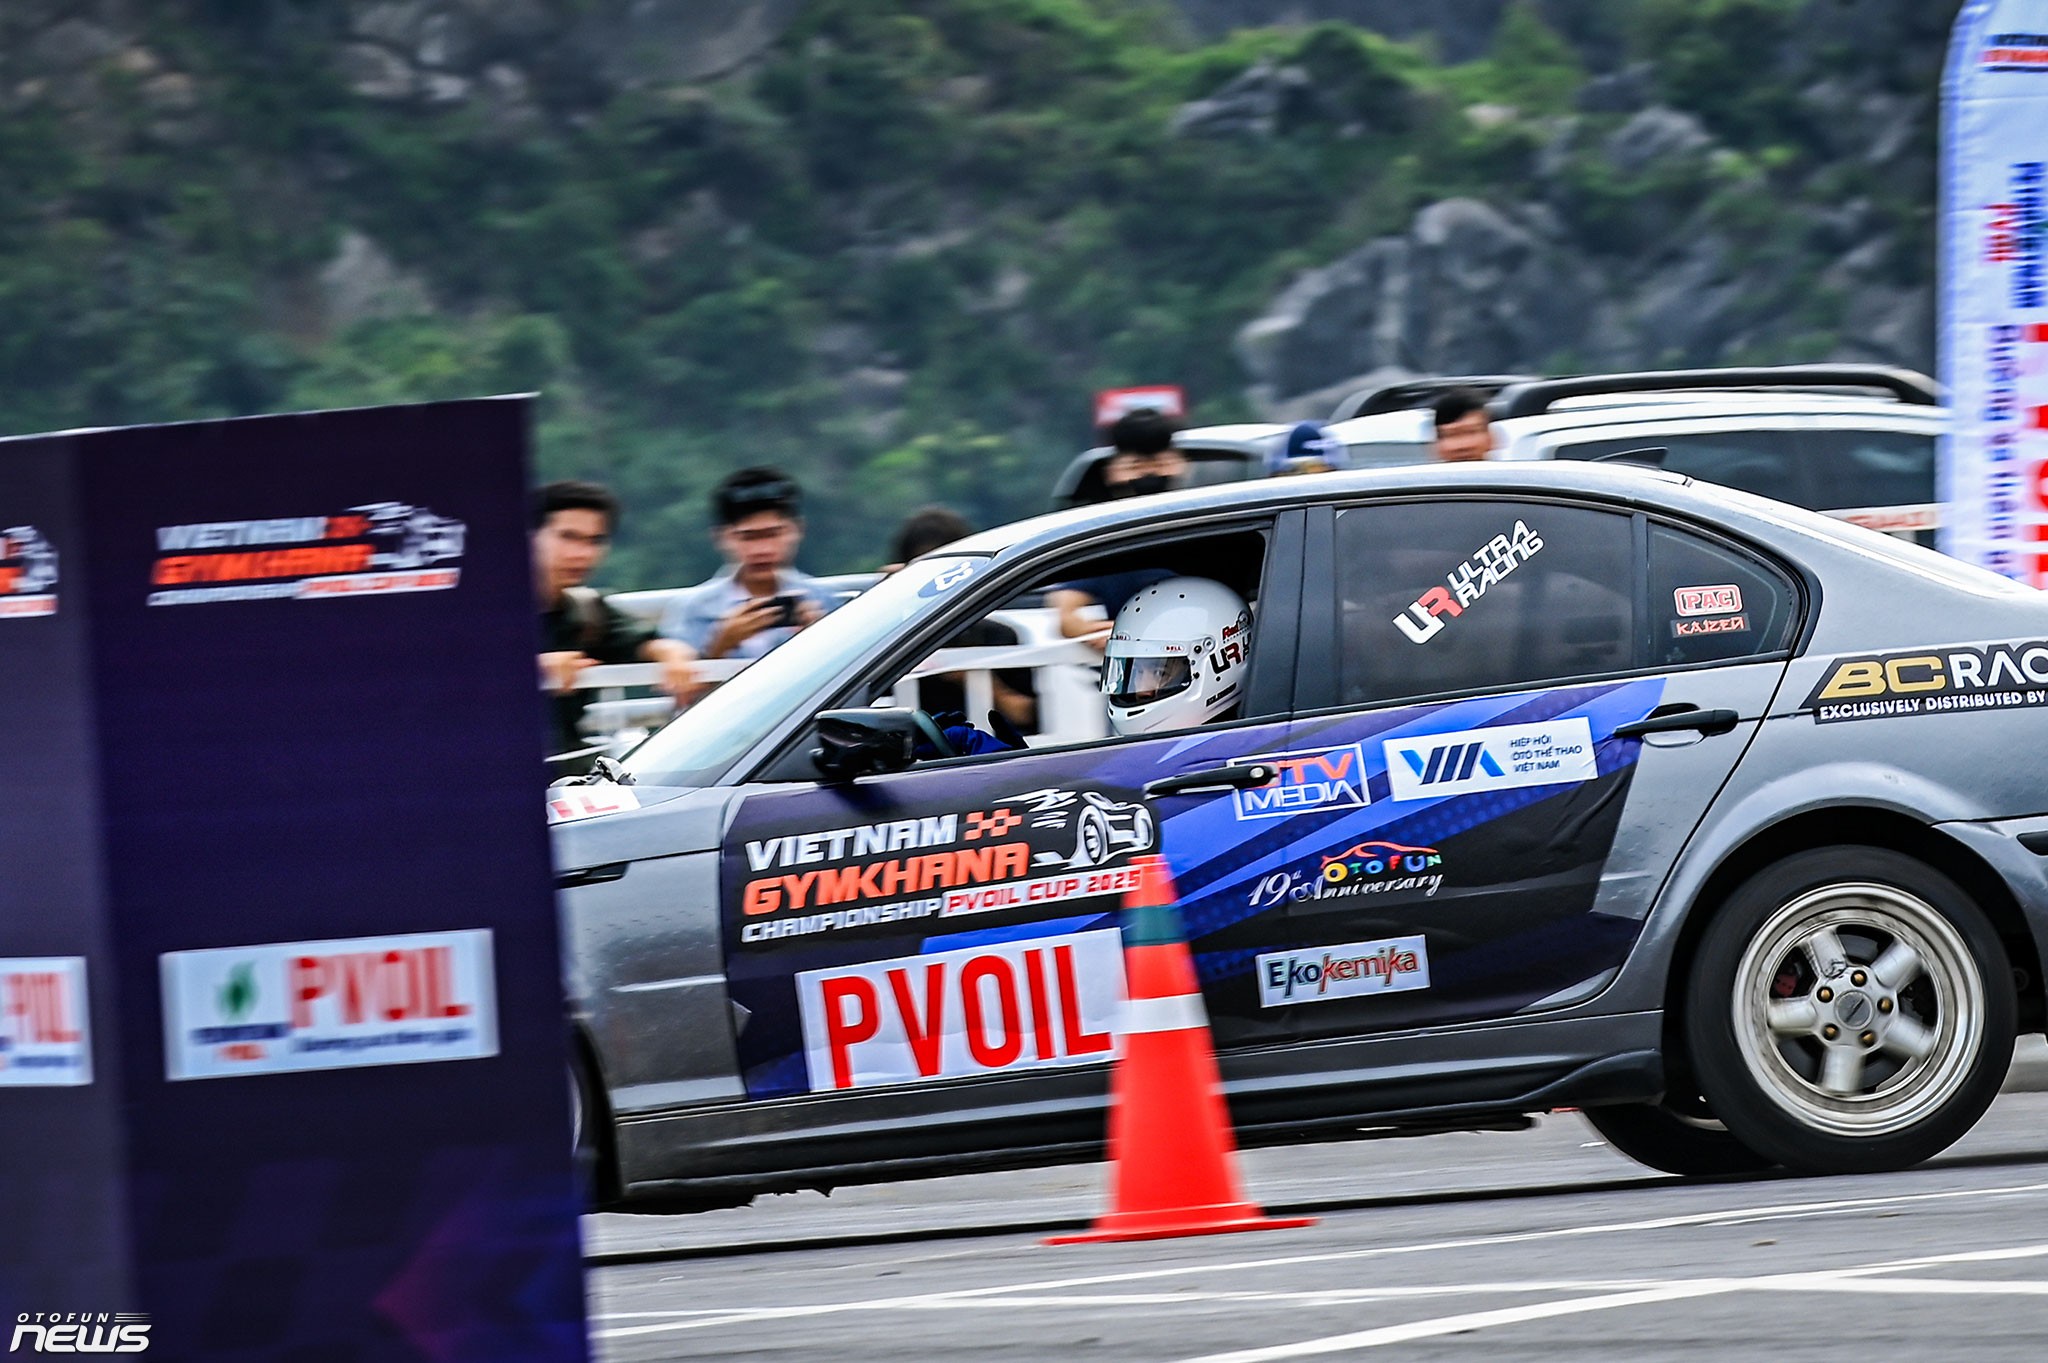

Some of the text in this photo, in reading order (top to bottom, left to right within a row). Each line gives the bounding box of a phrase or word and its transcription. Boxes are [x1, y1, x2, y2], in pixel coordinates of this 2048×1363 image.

[1447, 519, 1530, 590] ULTRA
[1455, 530, 1544, 609] RACING
[1392, 585, 1463, 644] UR
[1685, 591, 1732, 610] PAC
[1209, 642, 1242, 674] UR
[1819, 689, 2046, 721] EXCLUSIVELY DISTRIBUTED BY
[1243, 780, 1364, 811] MEDIA
[745, 814, 959, 872] VIETNAM
[1322, 854, 1442, 883] OTOFUN
[741, 869, 1141, 944] CHAMPIONSHIP PVOIL CUP 2025
[742, 842, 1030, 916] GYMKHANA
[1289, 873, 1444, 903] Anniversary
[1266, 945, 1420, 997] Ekokemika
[820, 945, 1112, 1089] PVOIL
